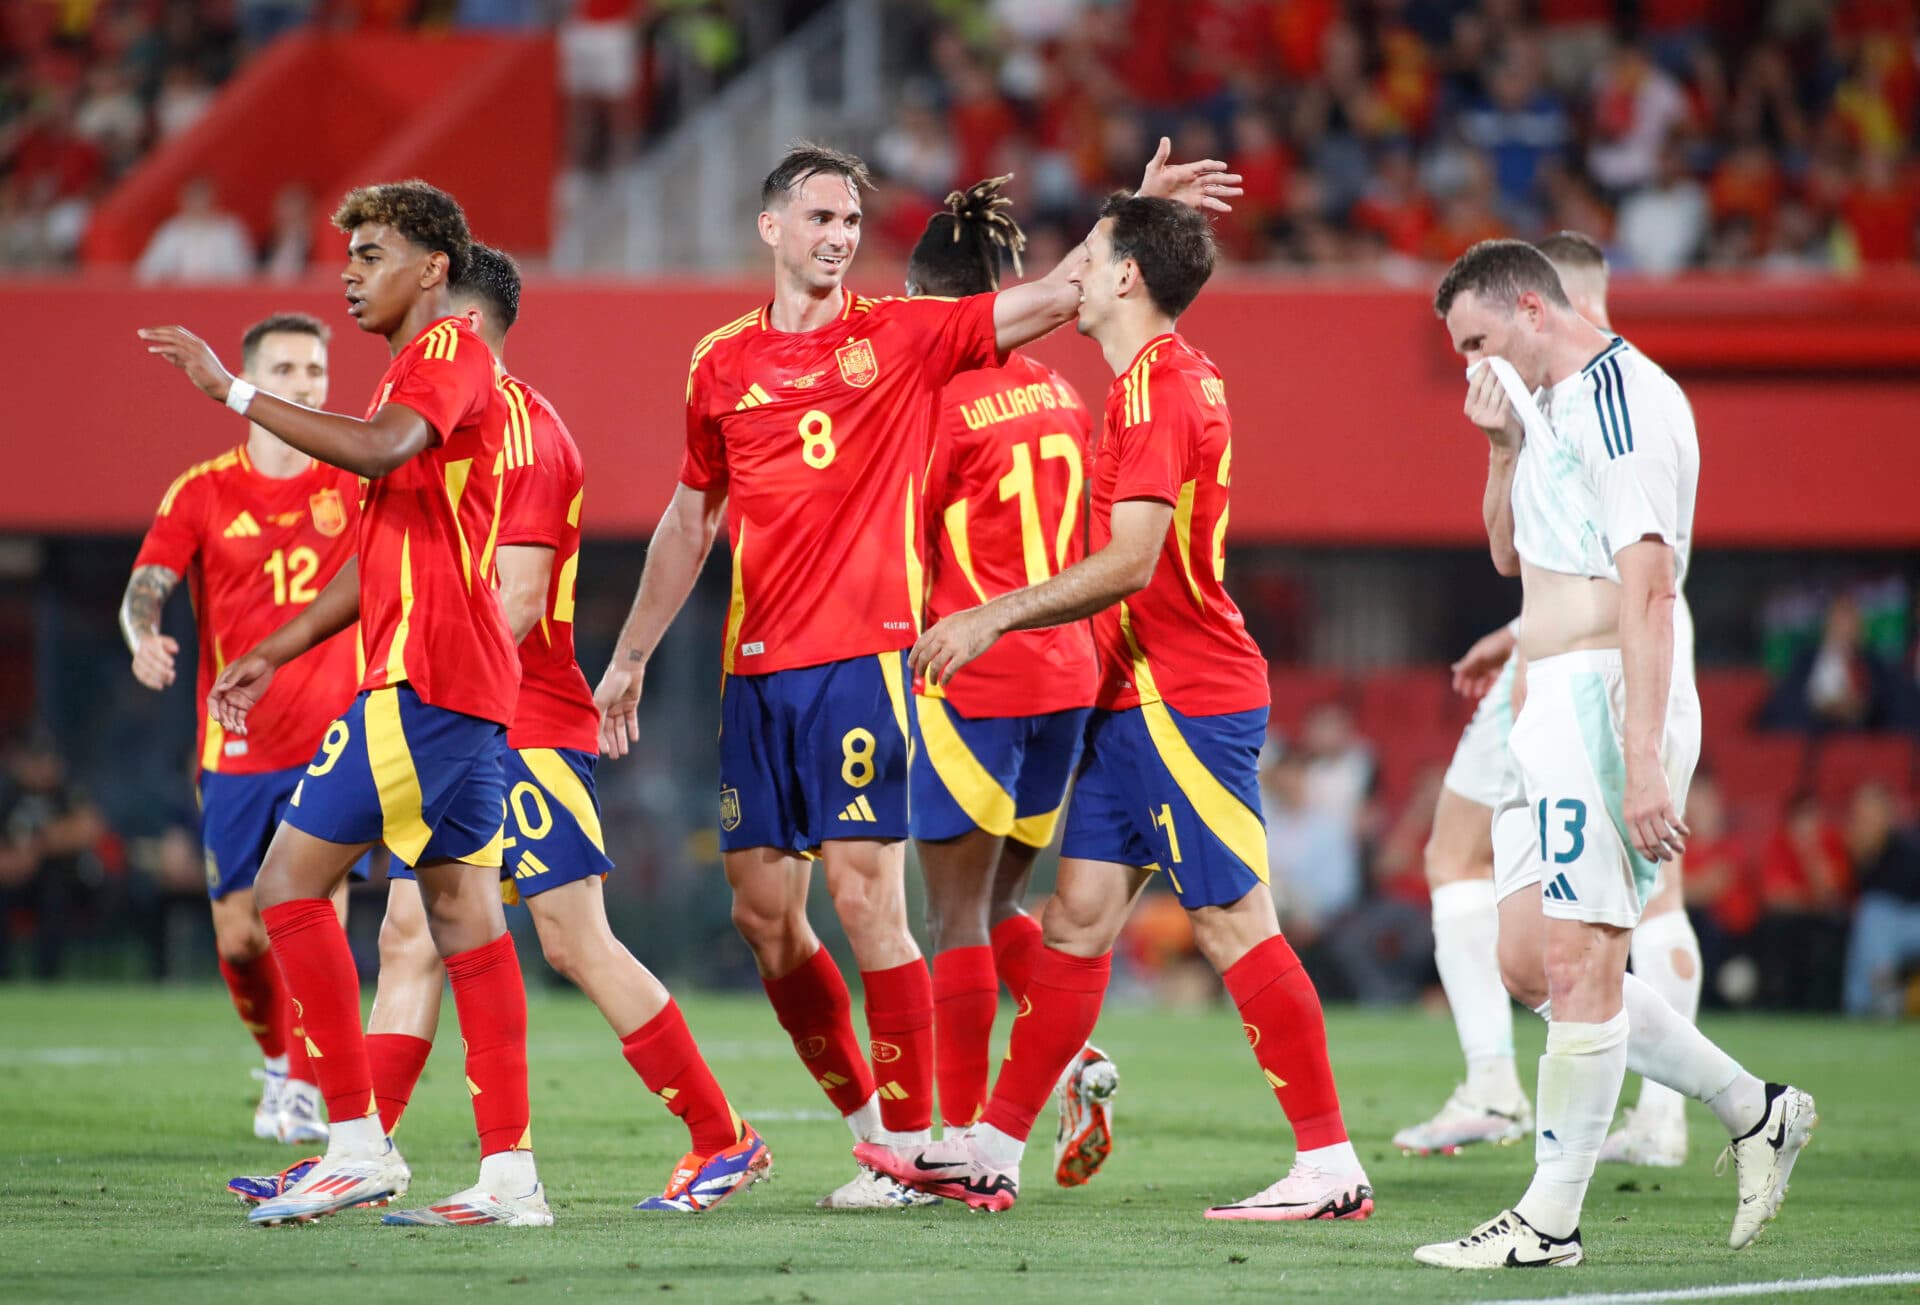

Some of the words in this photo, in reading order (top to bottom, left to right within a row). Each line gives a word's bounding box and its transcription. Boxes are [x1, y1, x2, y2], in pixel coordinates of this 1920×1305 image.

[960, 383, 1056, 430] WILLIAMS
[798, 409, 836, 469] 8
[999, 433, 1083, 586] 17
[263, 546, 319, 606] 12
[841, 727, 876, 788] 8
[1538, 797, 1587, 864] 13
